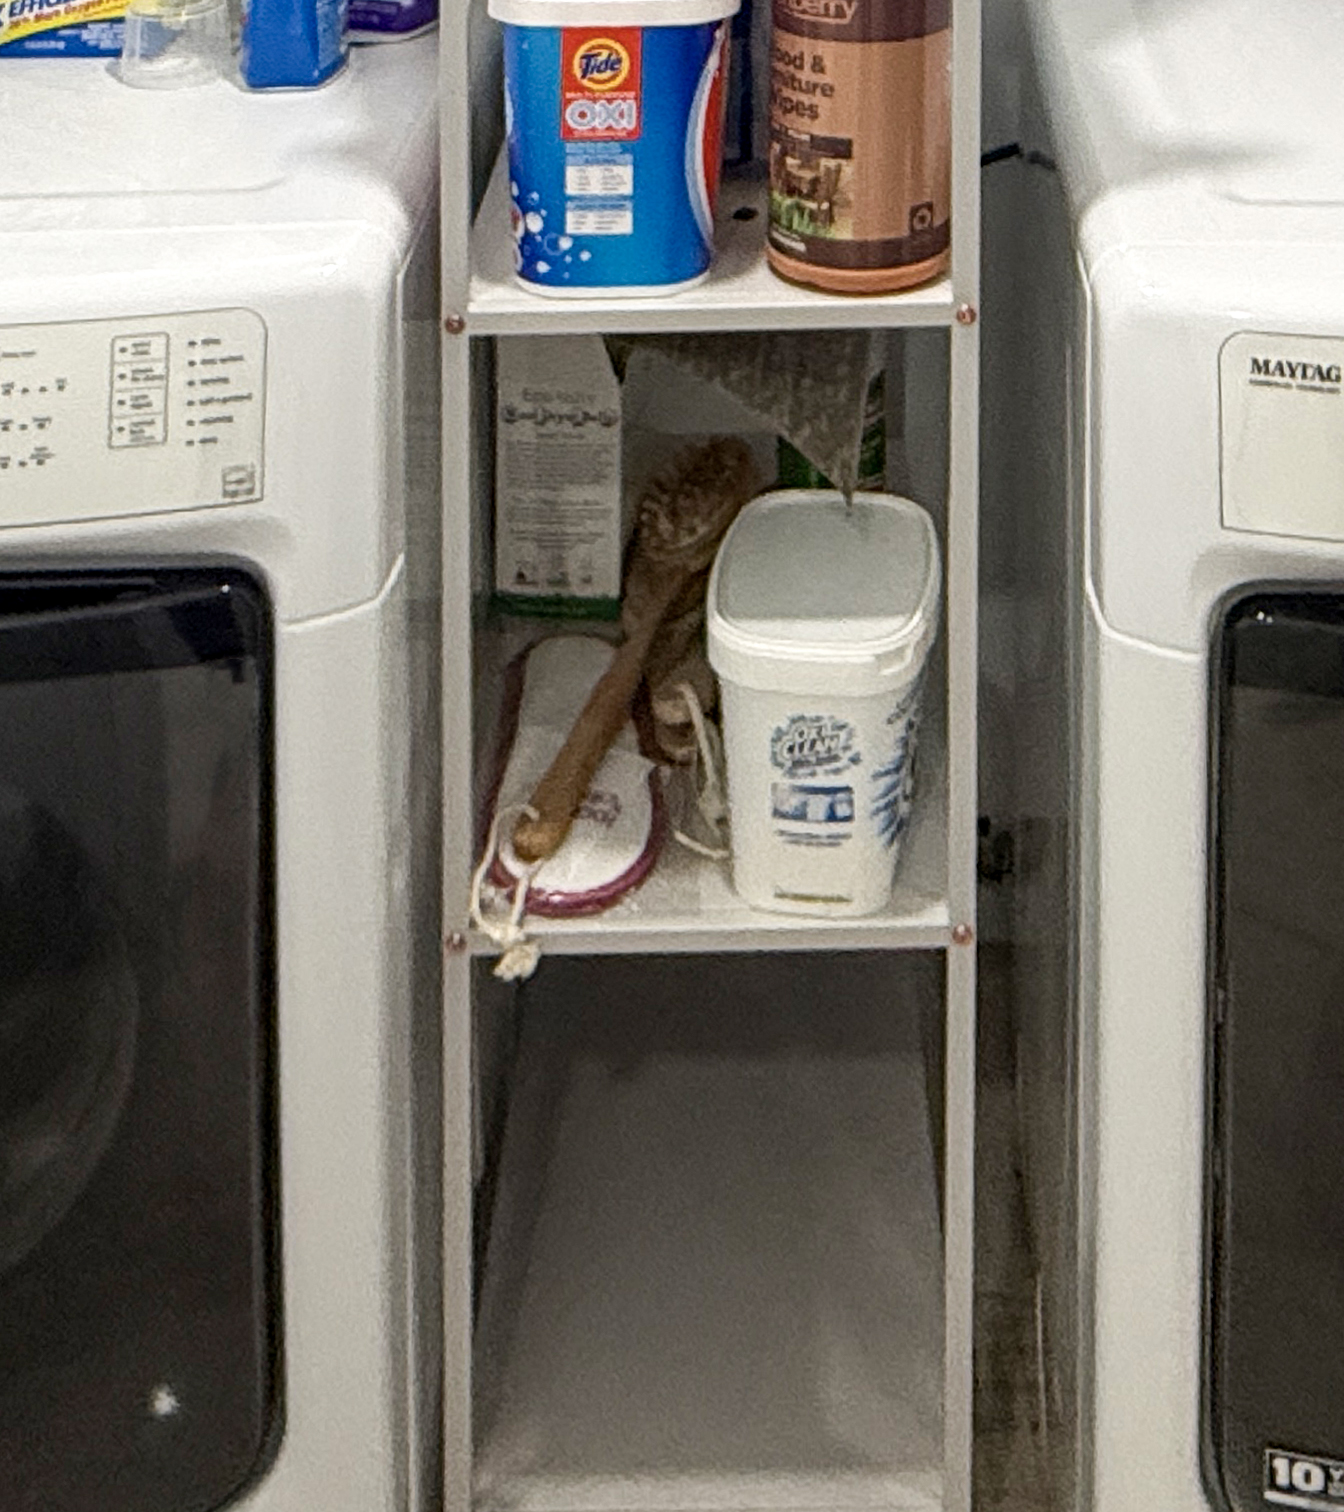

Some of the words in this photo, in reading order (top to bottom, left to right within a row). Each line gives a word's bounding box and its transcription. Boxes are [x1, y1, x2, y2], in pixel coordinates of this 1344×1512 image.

[579, 51, 623, 80] Tide
[774, 46, 804, 71] ood
[810, 54, 826, 74] &
[566, 100, 637, 130] OXI
[773, 92, 820, 120] ipes
[1250, 357, 1342, 384] MAYTAG
[1272, 1456, 1326, 1492] 10
